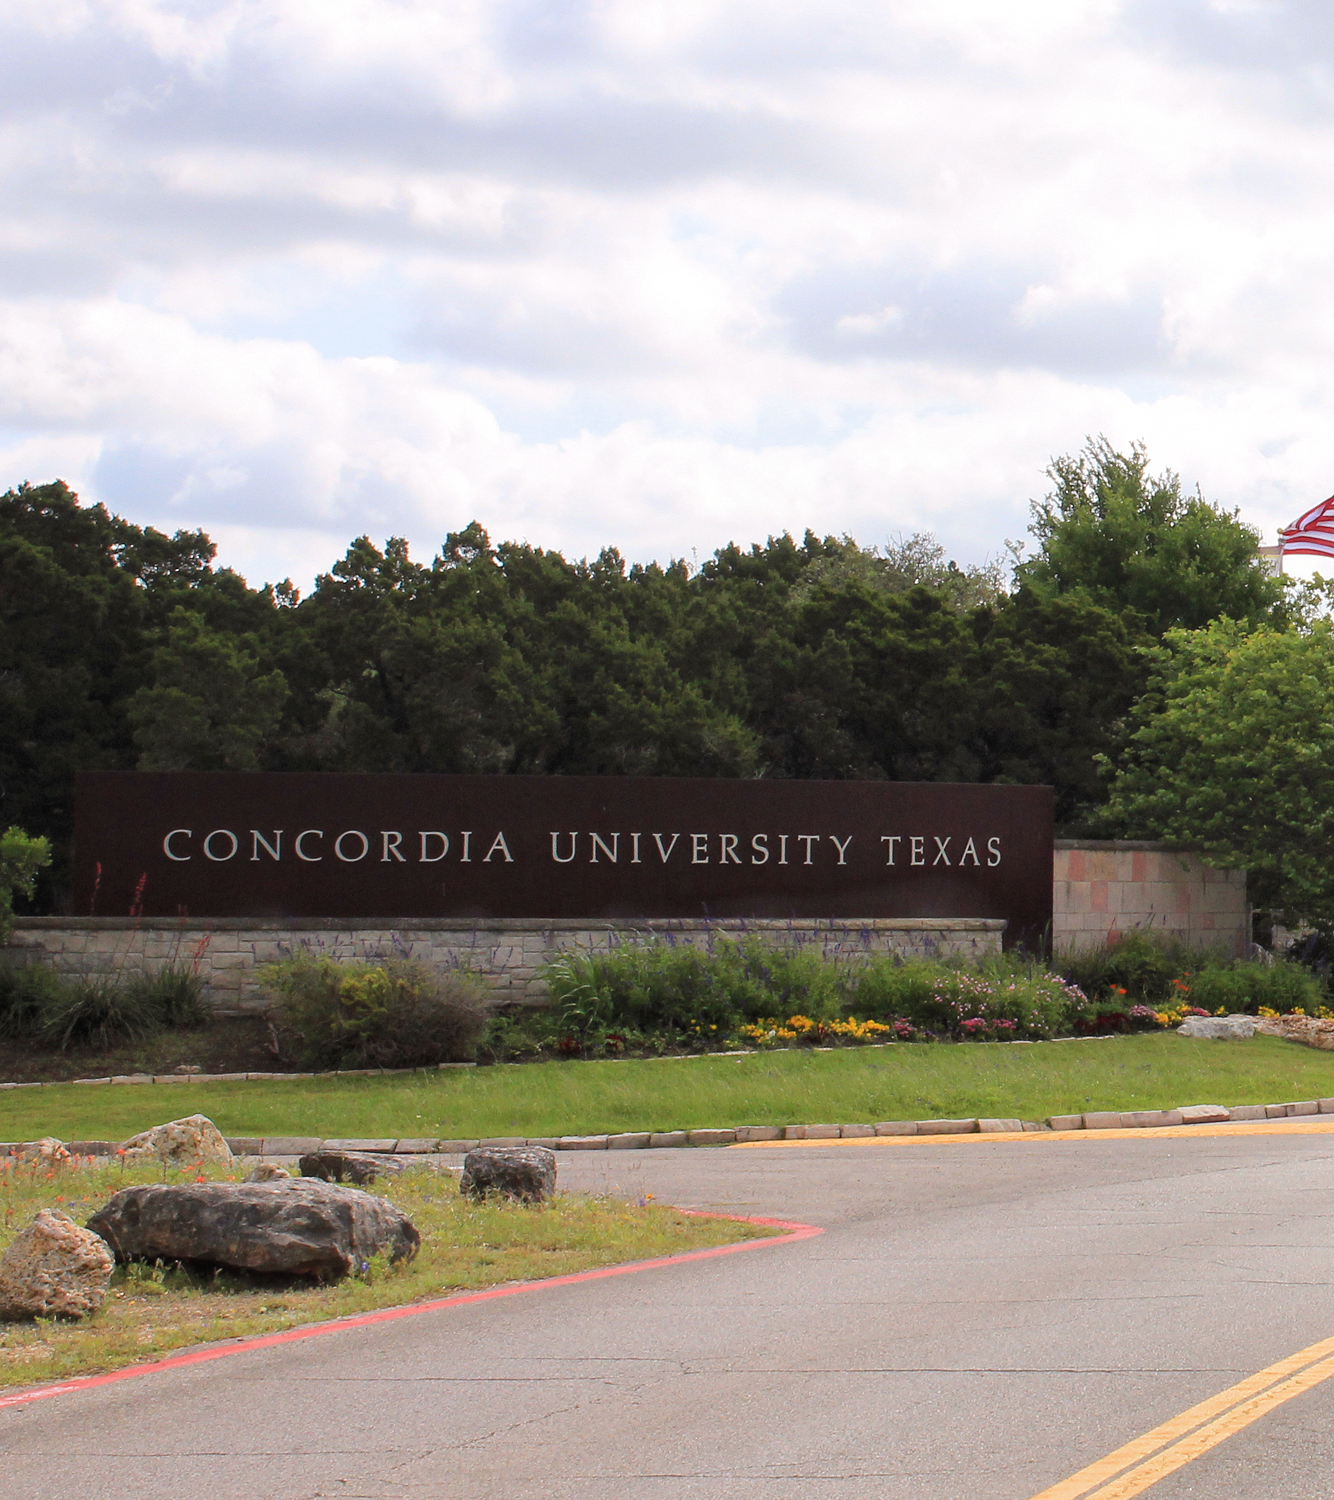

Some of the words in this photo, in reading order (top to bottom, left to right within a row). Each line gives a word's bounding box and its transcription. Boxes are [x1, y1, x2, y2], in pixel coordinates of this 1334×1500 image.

[162, 828, 514, 862] CONCORDIA
[549, 831, 853, 865] UNIVERSITY
[880, 835, 1002, 867] TEXAS
